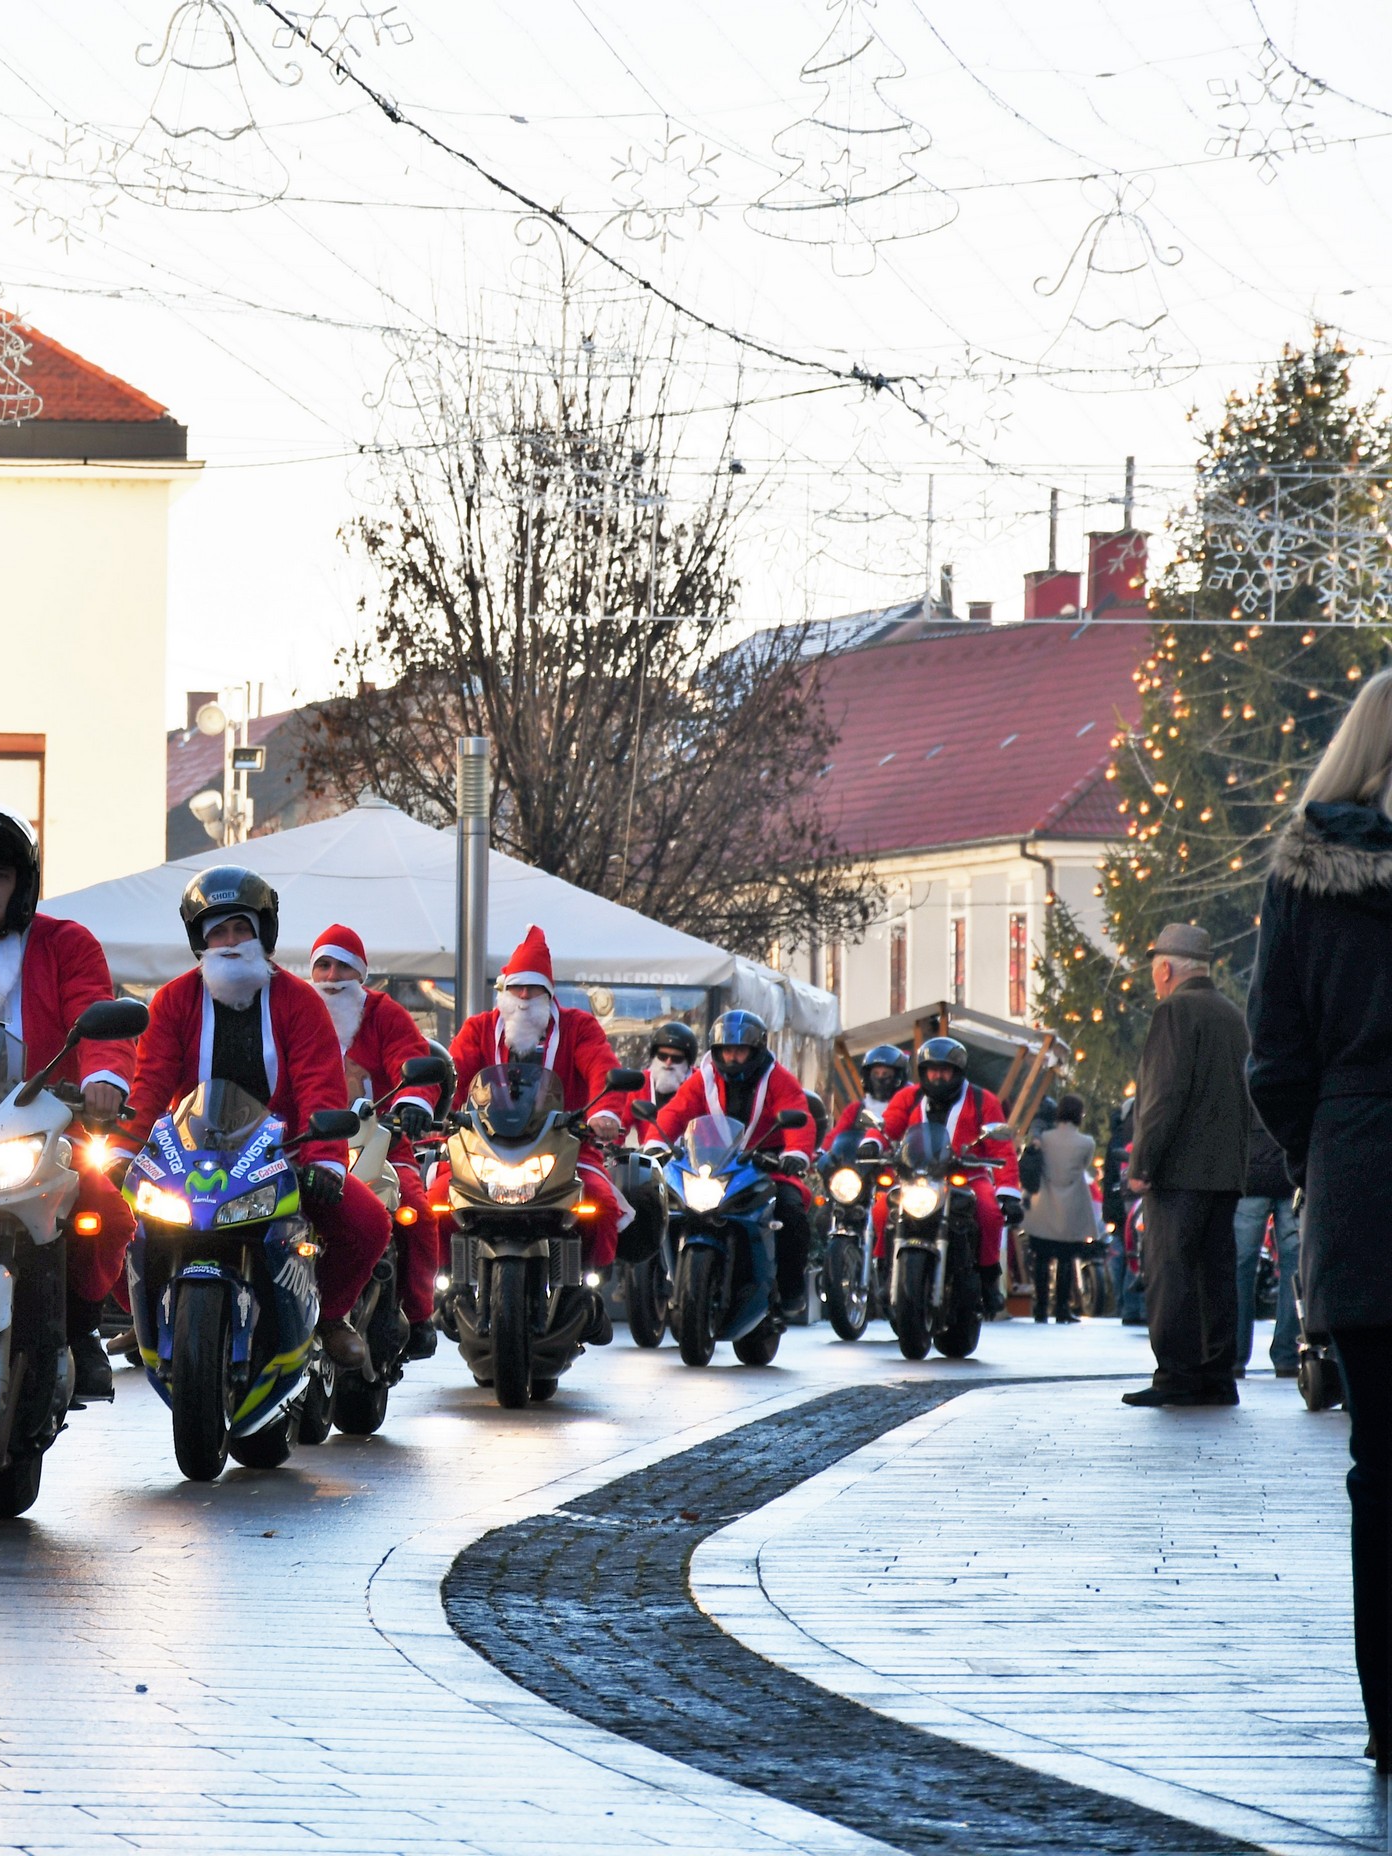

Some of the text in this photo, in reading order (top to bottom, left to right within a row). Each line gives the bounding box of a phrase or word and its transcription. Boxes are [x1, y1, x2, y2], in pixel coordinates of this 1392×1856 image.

[211, 891, 236, 901] SHOEI
[139, 1157, 163, 1178] Castrol
[257, 1160, 286, 1178] Castrol
